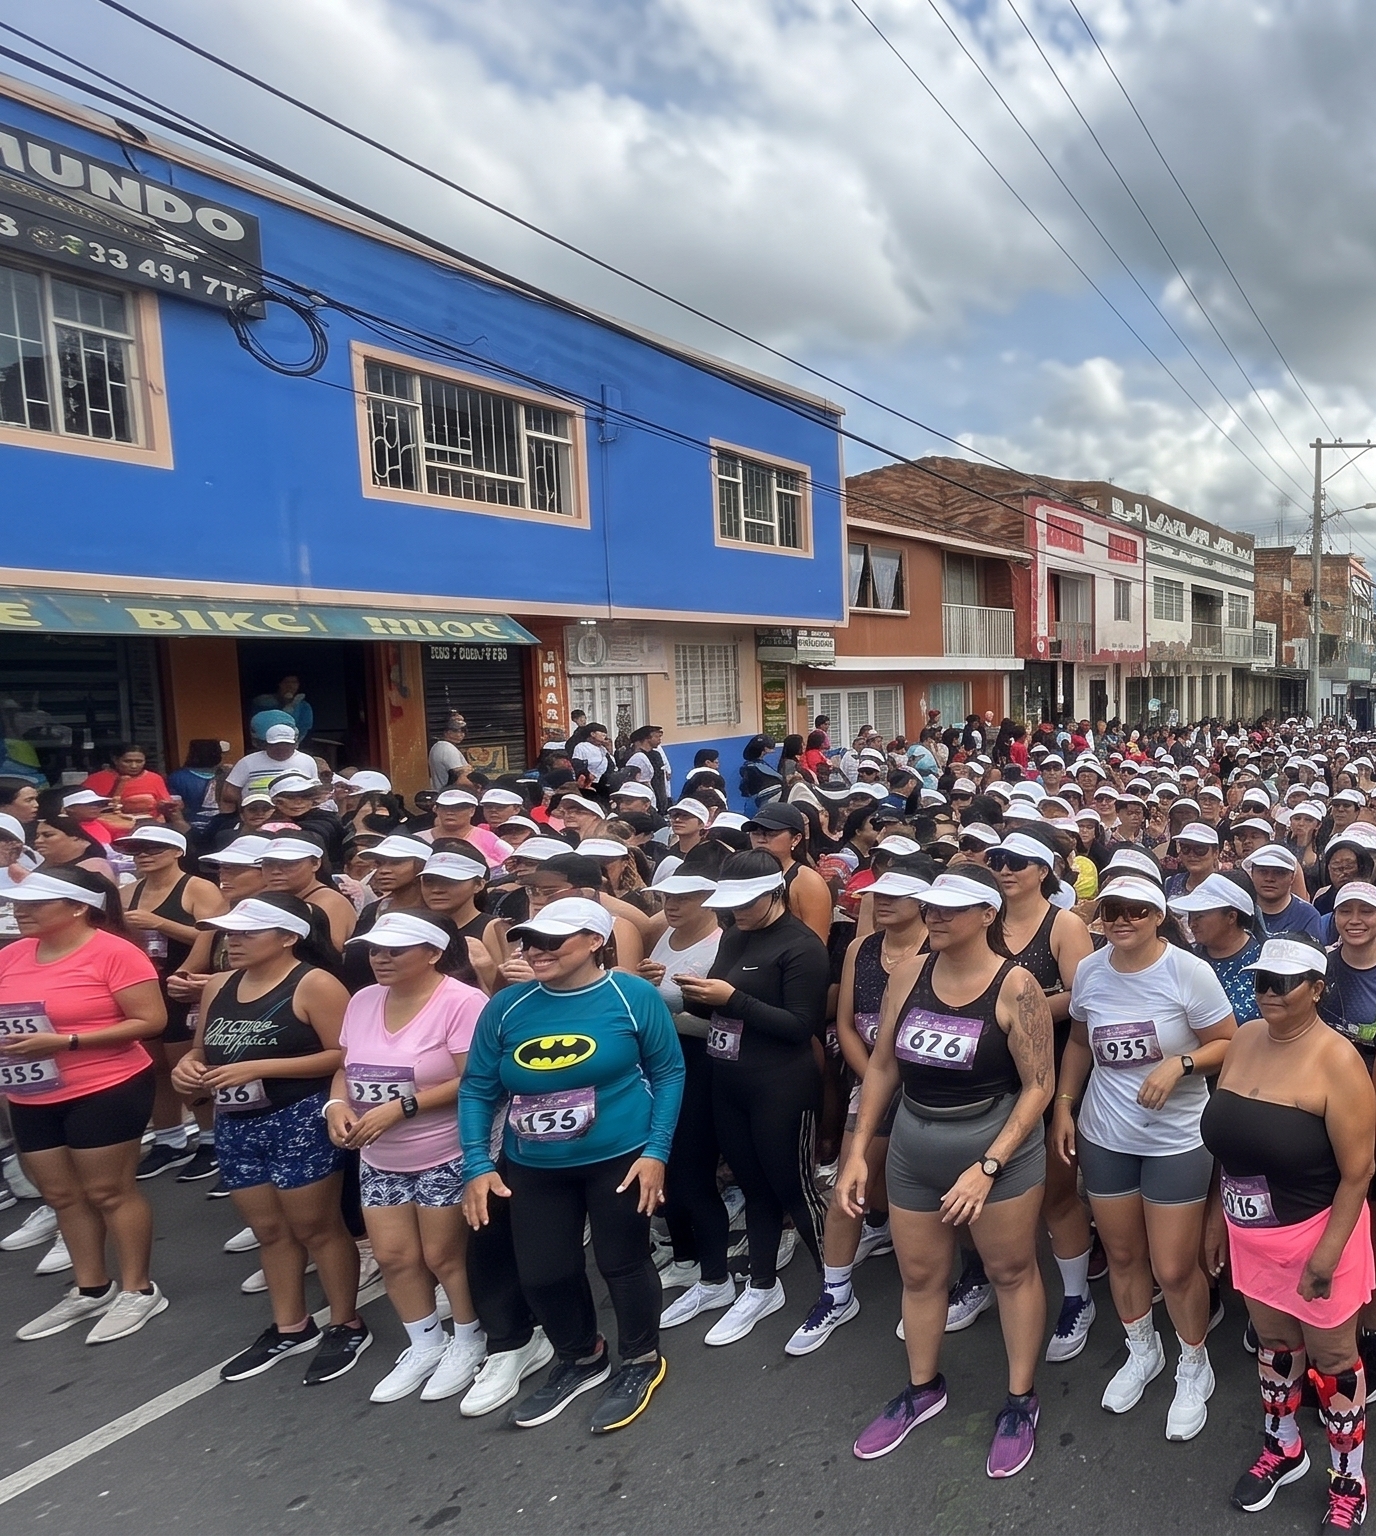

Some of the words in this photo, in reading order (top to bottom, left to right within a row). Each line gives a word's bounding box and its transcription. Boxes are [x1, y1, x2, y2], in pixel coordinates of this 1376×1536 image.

[89, 242, 128, 270] 33
[909, 1029, 961, 1058] 626
[1106, 1039, 1147, 1060] 935
